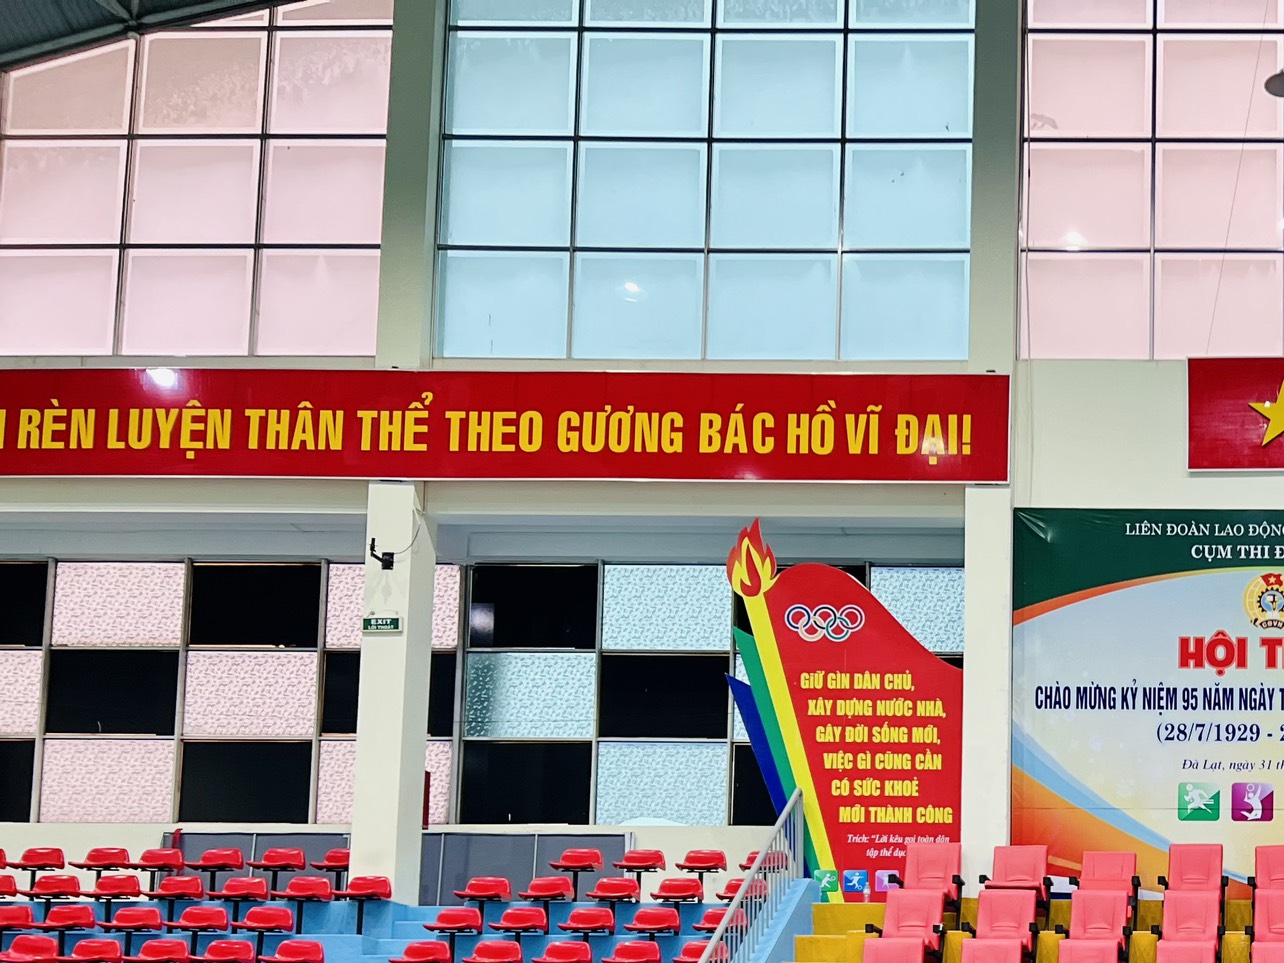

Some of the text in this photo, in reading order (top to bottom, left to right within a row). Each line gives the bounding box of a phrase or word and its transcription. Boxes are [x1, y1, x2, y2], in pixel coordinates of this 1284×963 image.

[18, 400, 95, 448] RÈN
[108, 400, 231, 459] LUYỆN
[245, 402, 344, 450] THÂN
[358, 392, 433, 451] THỂ
[446, 411, 543, 452] THEO
[558, 406, 683, 453] GƯƠNG
[700, 404, 774, 454] BÁC
[788, 400, 836, 455] HỒ
[846, 406, 882, 454] VĨ
[896, 414, 971, 464] ĐẠI!
[1126, 520, 1162, 535] LIÊN
[1167, 521, 1210, 535] ĐOÀN
[1215, 524, 1244, 536] LAO
[1191, 545, 1232, 562] CỤM
[1237, 545, 1269, 558] THI
[1178, 630, 1248, 677] HỘI
[827, 671, 850, 689] GÌN
[854, 671, 880, 689] DÂN
[884, 670, 914, 691] CHỦ,
[808, 697, 833, 715] XÂY
[837, 698, 872, 718] DỰNG
[917, 698, 946, 718] NHÀ,
[1036, 681, 1070, 709] CHÀO
[1076, 681, 1116, 710] MỪNG
[1121, 681, 1138, 709] KỶ
[1143, 681, 1177, 715] NIỆM
[1182, 688, 1198, 710] 95
[1203, 681, 1233, 710] NĂM
[1239, 681, 1274, 710] NGÀY
[816, 722, 940, 744] GÂY ĐỜI SỐNG MỚI,
[1157, 723, 1260, 743] (28/7/1929
[823, 749, 942, 772] VIỆC GÌ CŨNG CẦN
[1182, 759, 1199, 770] Đà
[1202, 759, 1225, 771] Lạt,
[1229, 760, 1255, 772] ngày
[1259, 759, 1272, 770] 31
[832, 778, 849, 796] CÓ
[854, 778, 880, 796] SỨC
[839, 804, 952, 823] MỚI THÀNH CÔNG
